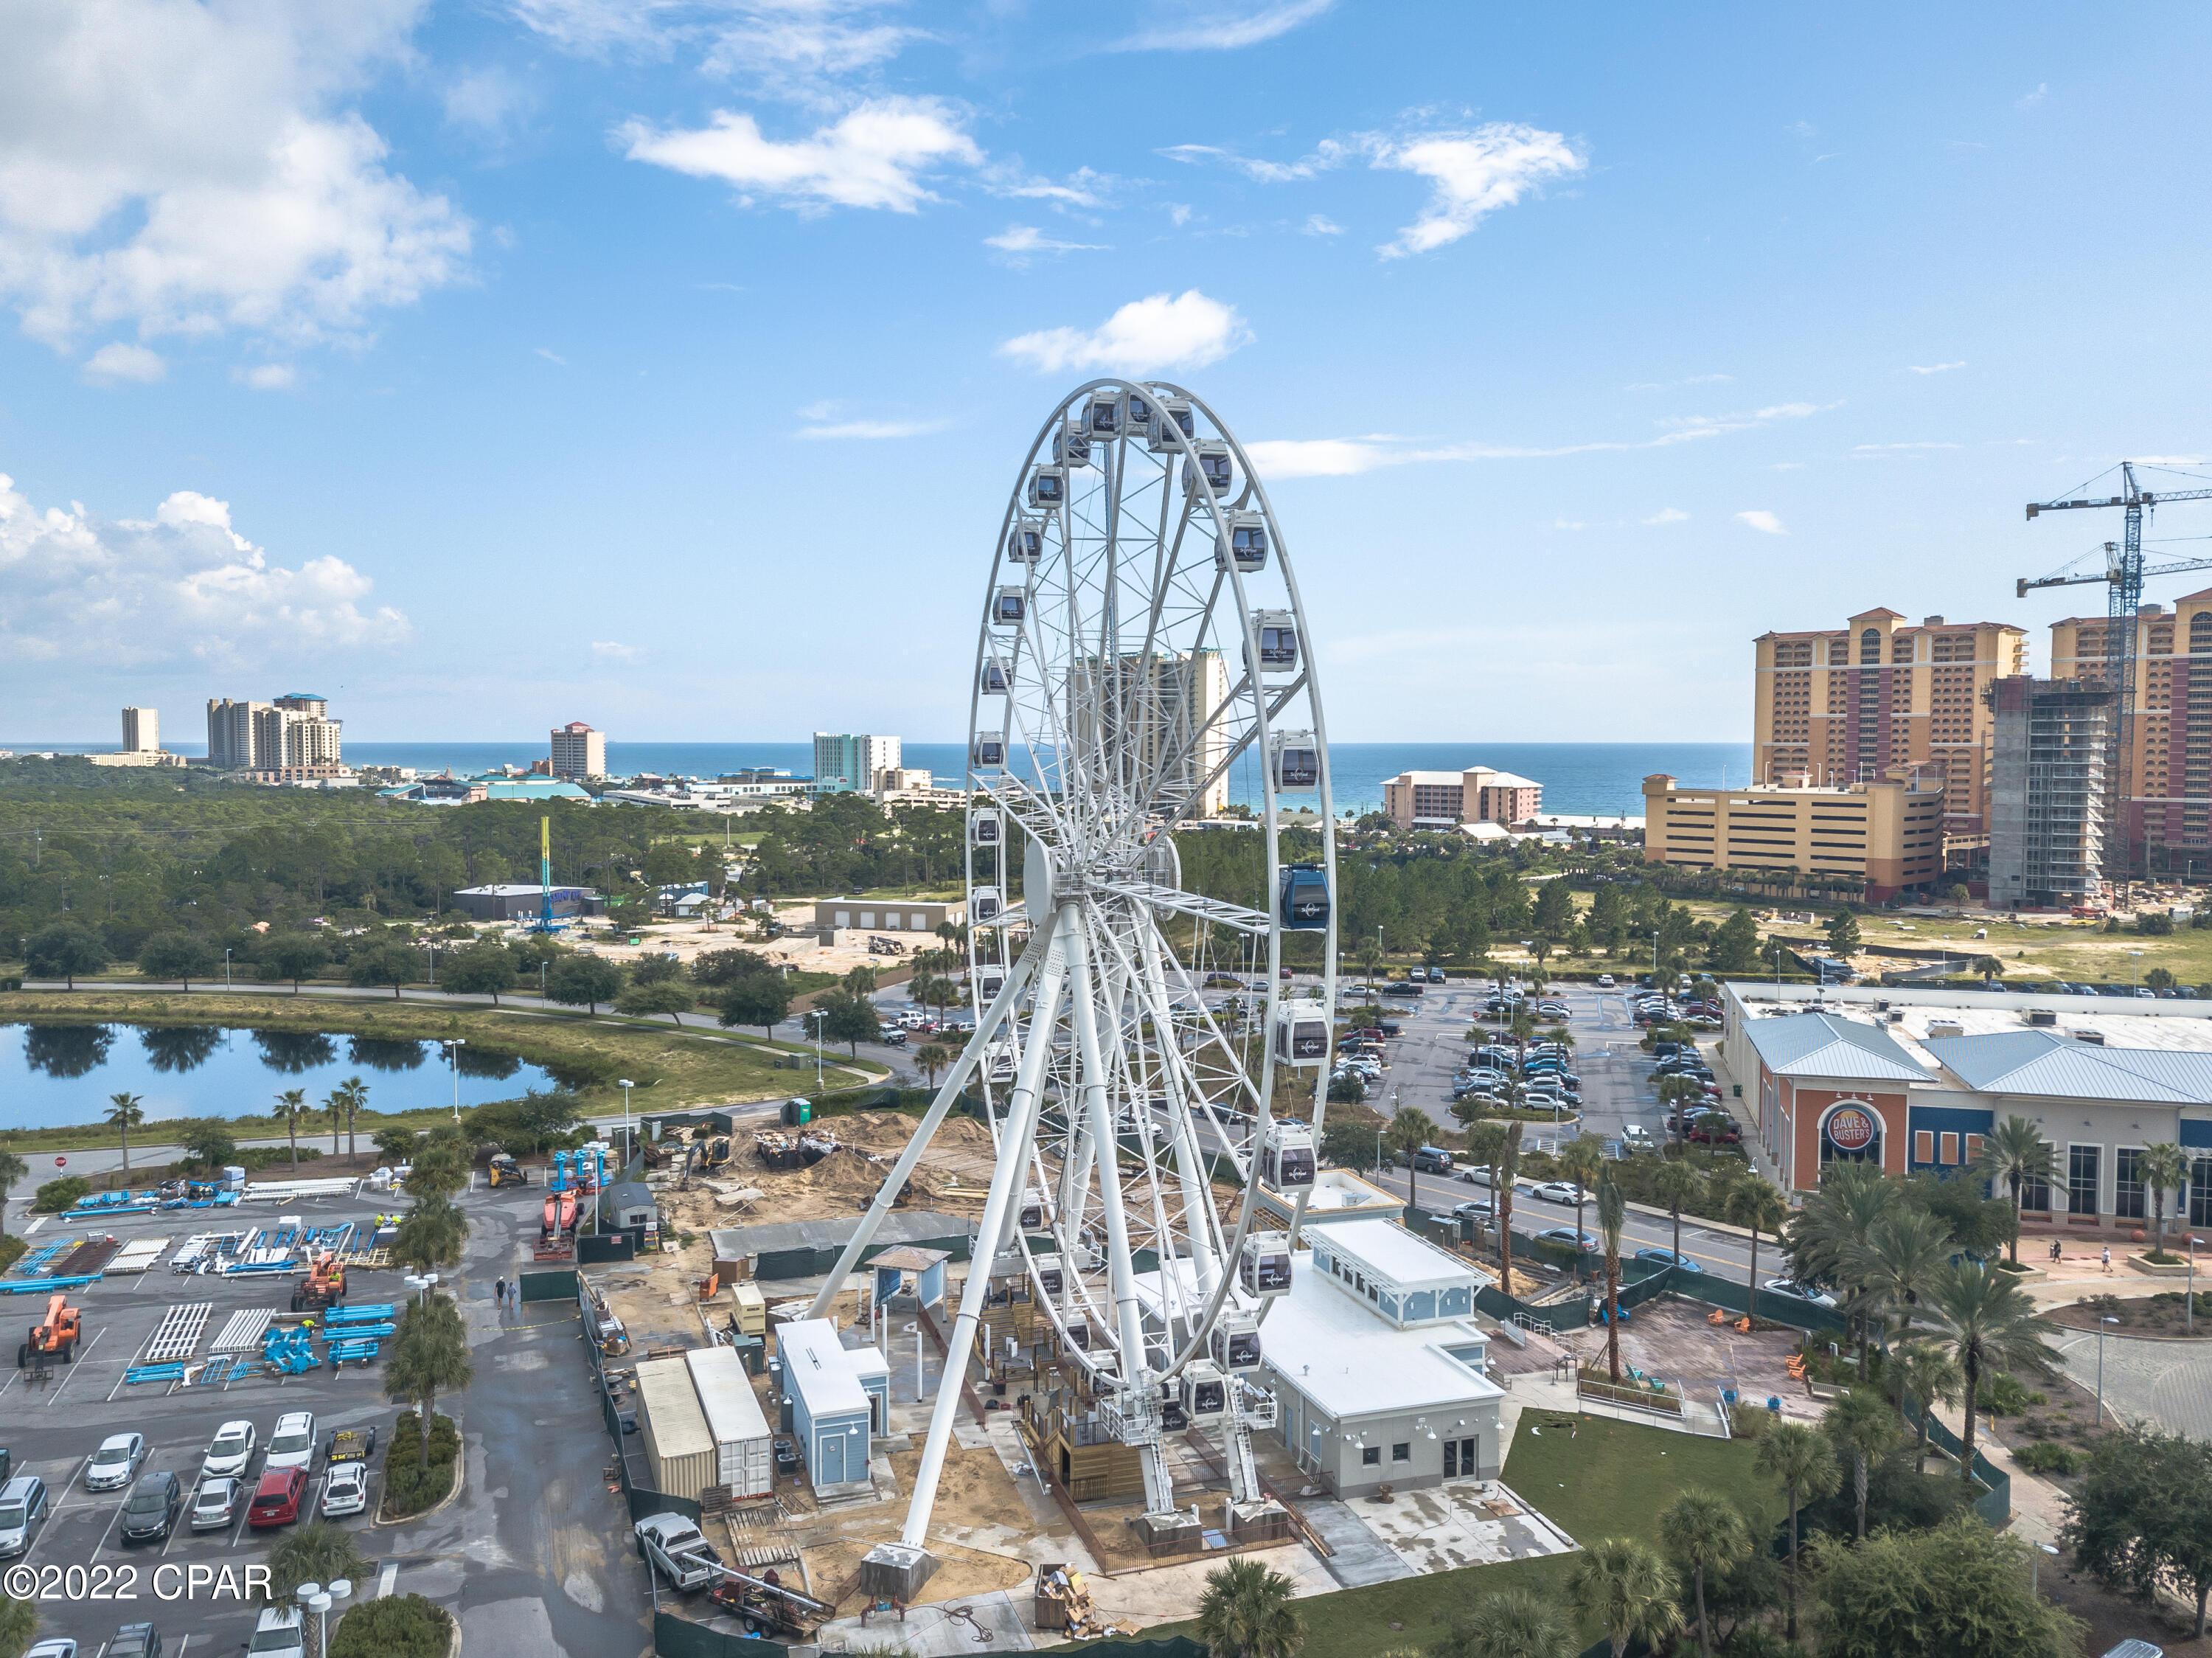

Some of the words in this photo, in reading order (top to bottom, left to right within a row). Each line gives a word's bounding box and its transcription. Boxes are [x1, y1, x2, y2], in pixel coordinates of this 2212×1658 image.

[1833, 1116, 1860, 1130] DAVE
[1860, 1117, 1869, 1128] &
[1834, 1128, 1870, 1140] BUSTER'S
